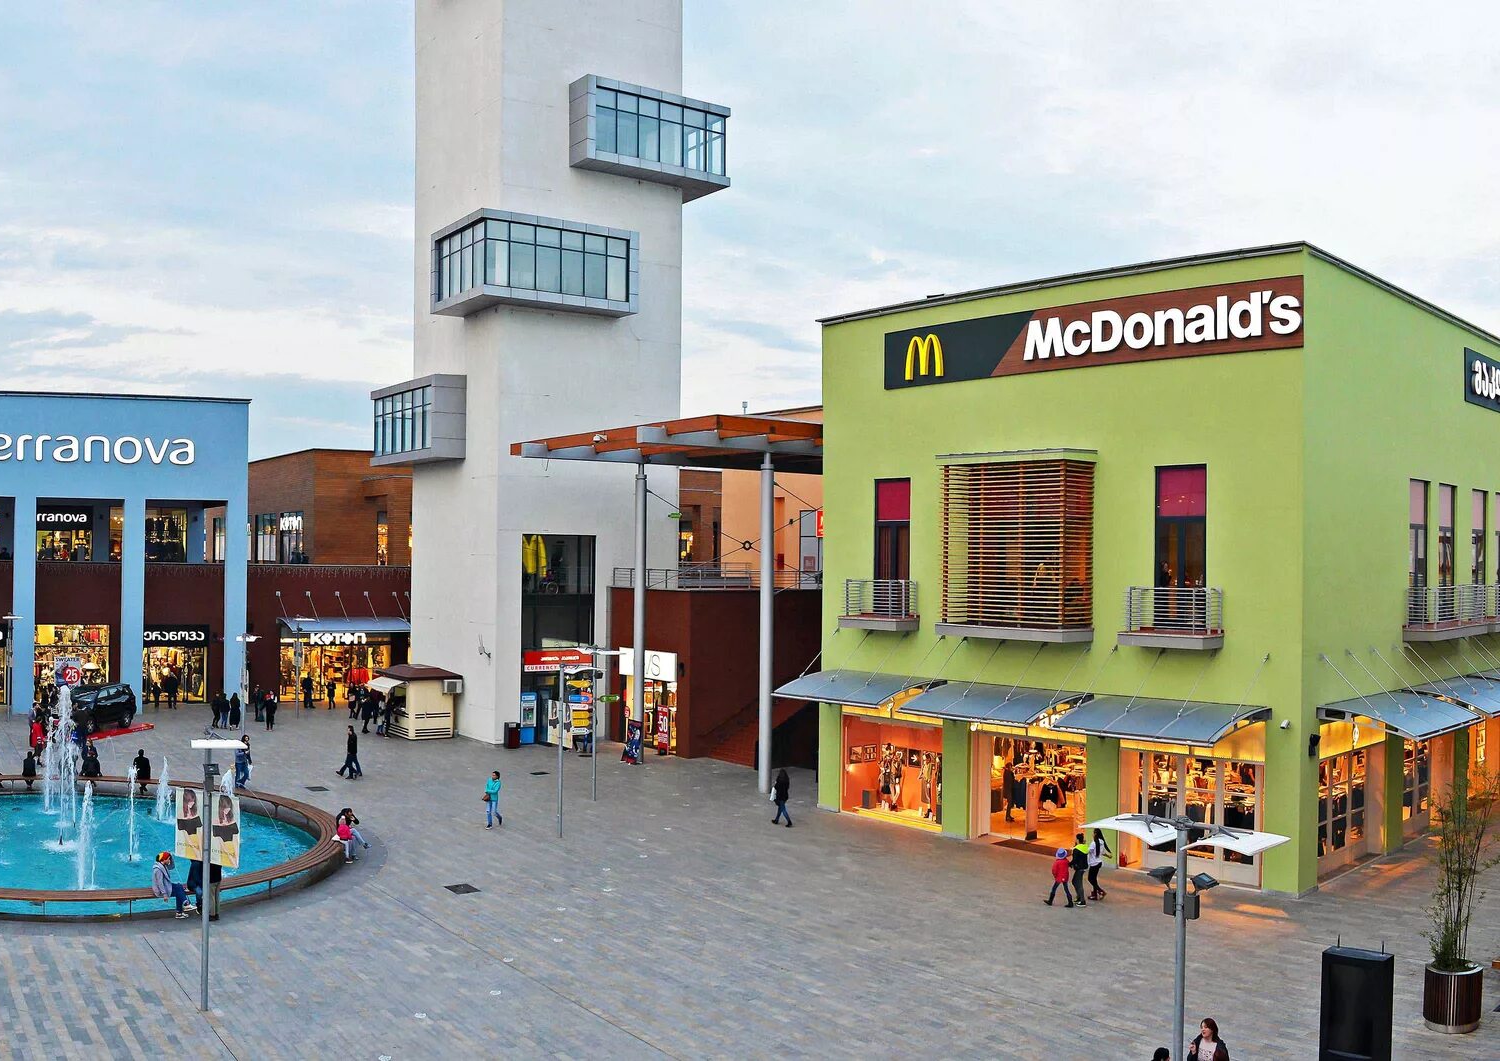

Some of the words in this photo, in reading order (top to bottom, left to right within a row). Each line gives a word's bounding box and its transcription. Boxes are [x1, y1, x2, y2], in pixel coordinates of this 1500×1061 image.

[1023, 290, 1301, 361] McDonald's
[36, 513, 88, 523] rranova
[143, 630, 205, 641] ერანოვა
[65, 669, 78, 682] 25
